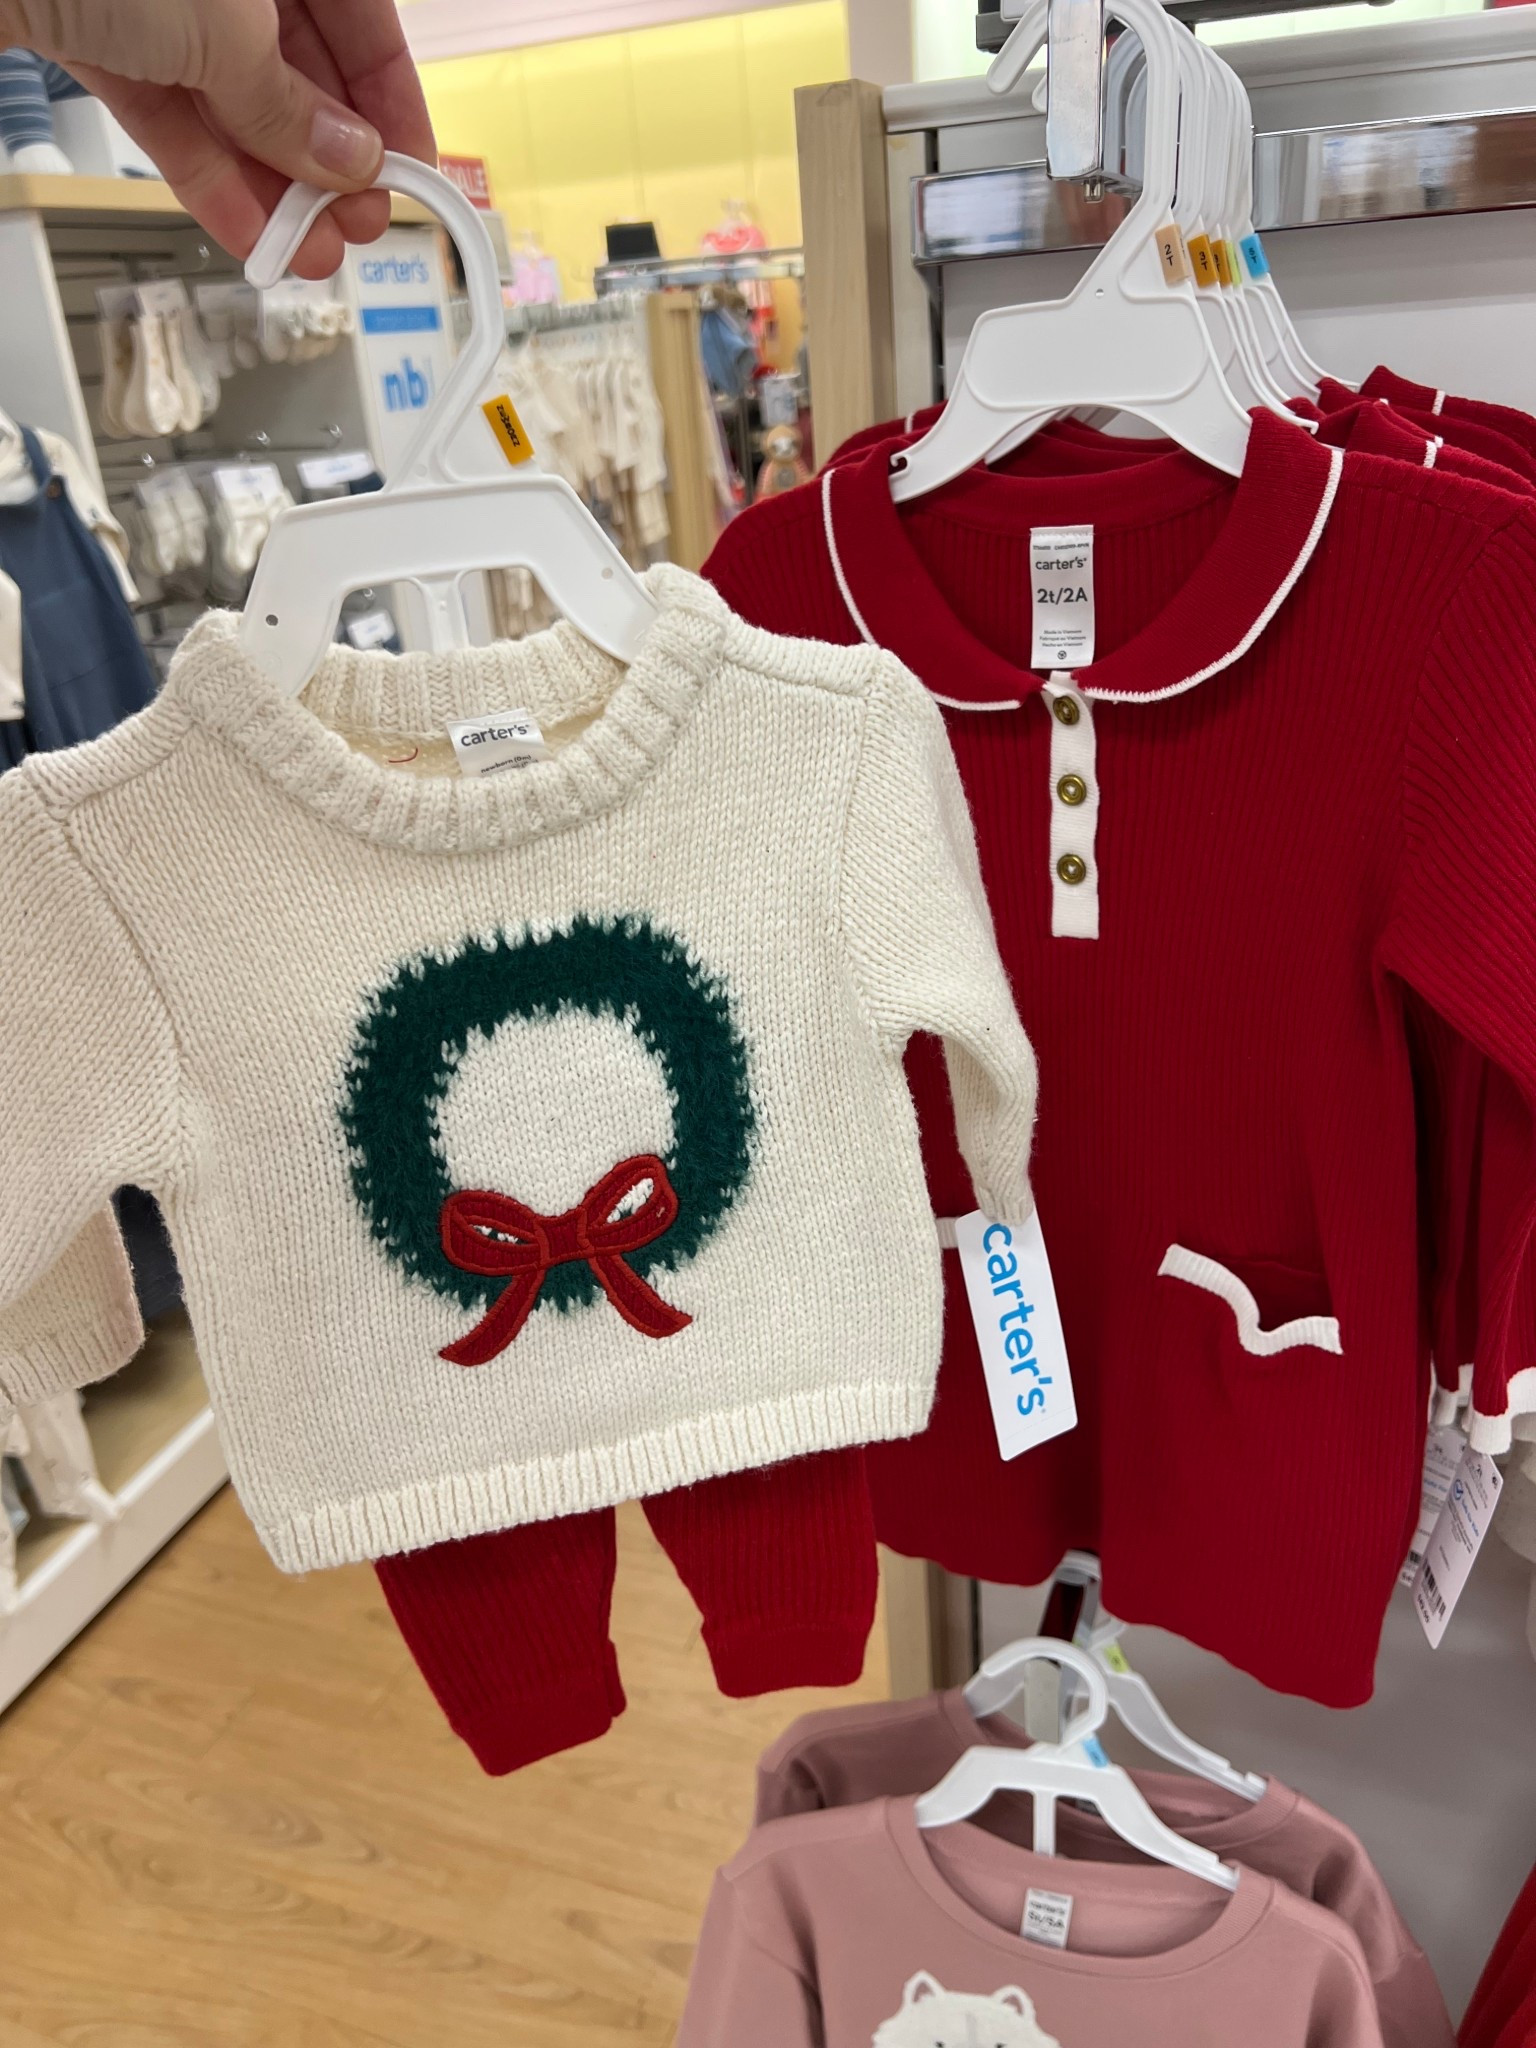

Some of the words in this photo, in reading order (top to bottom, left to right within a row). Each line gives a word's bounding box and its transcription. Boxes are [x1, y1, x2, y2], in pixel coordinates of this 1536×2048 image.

[361, 257, 429, 284] carter's
[383, 356, 428, 412] nb
[1035, 556, 1084, 570] carter's
[1037, 587, 1088, 605] 2t/2A
[461, 724, 528, 747] carter's
[480, 758, 514, 773] newborn
[983, 1223, 1052, 1416] carter's
